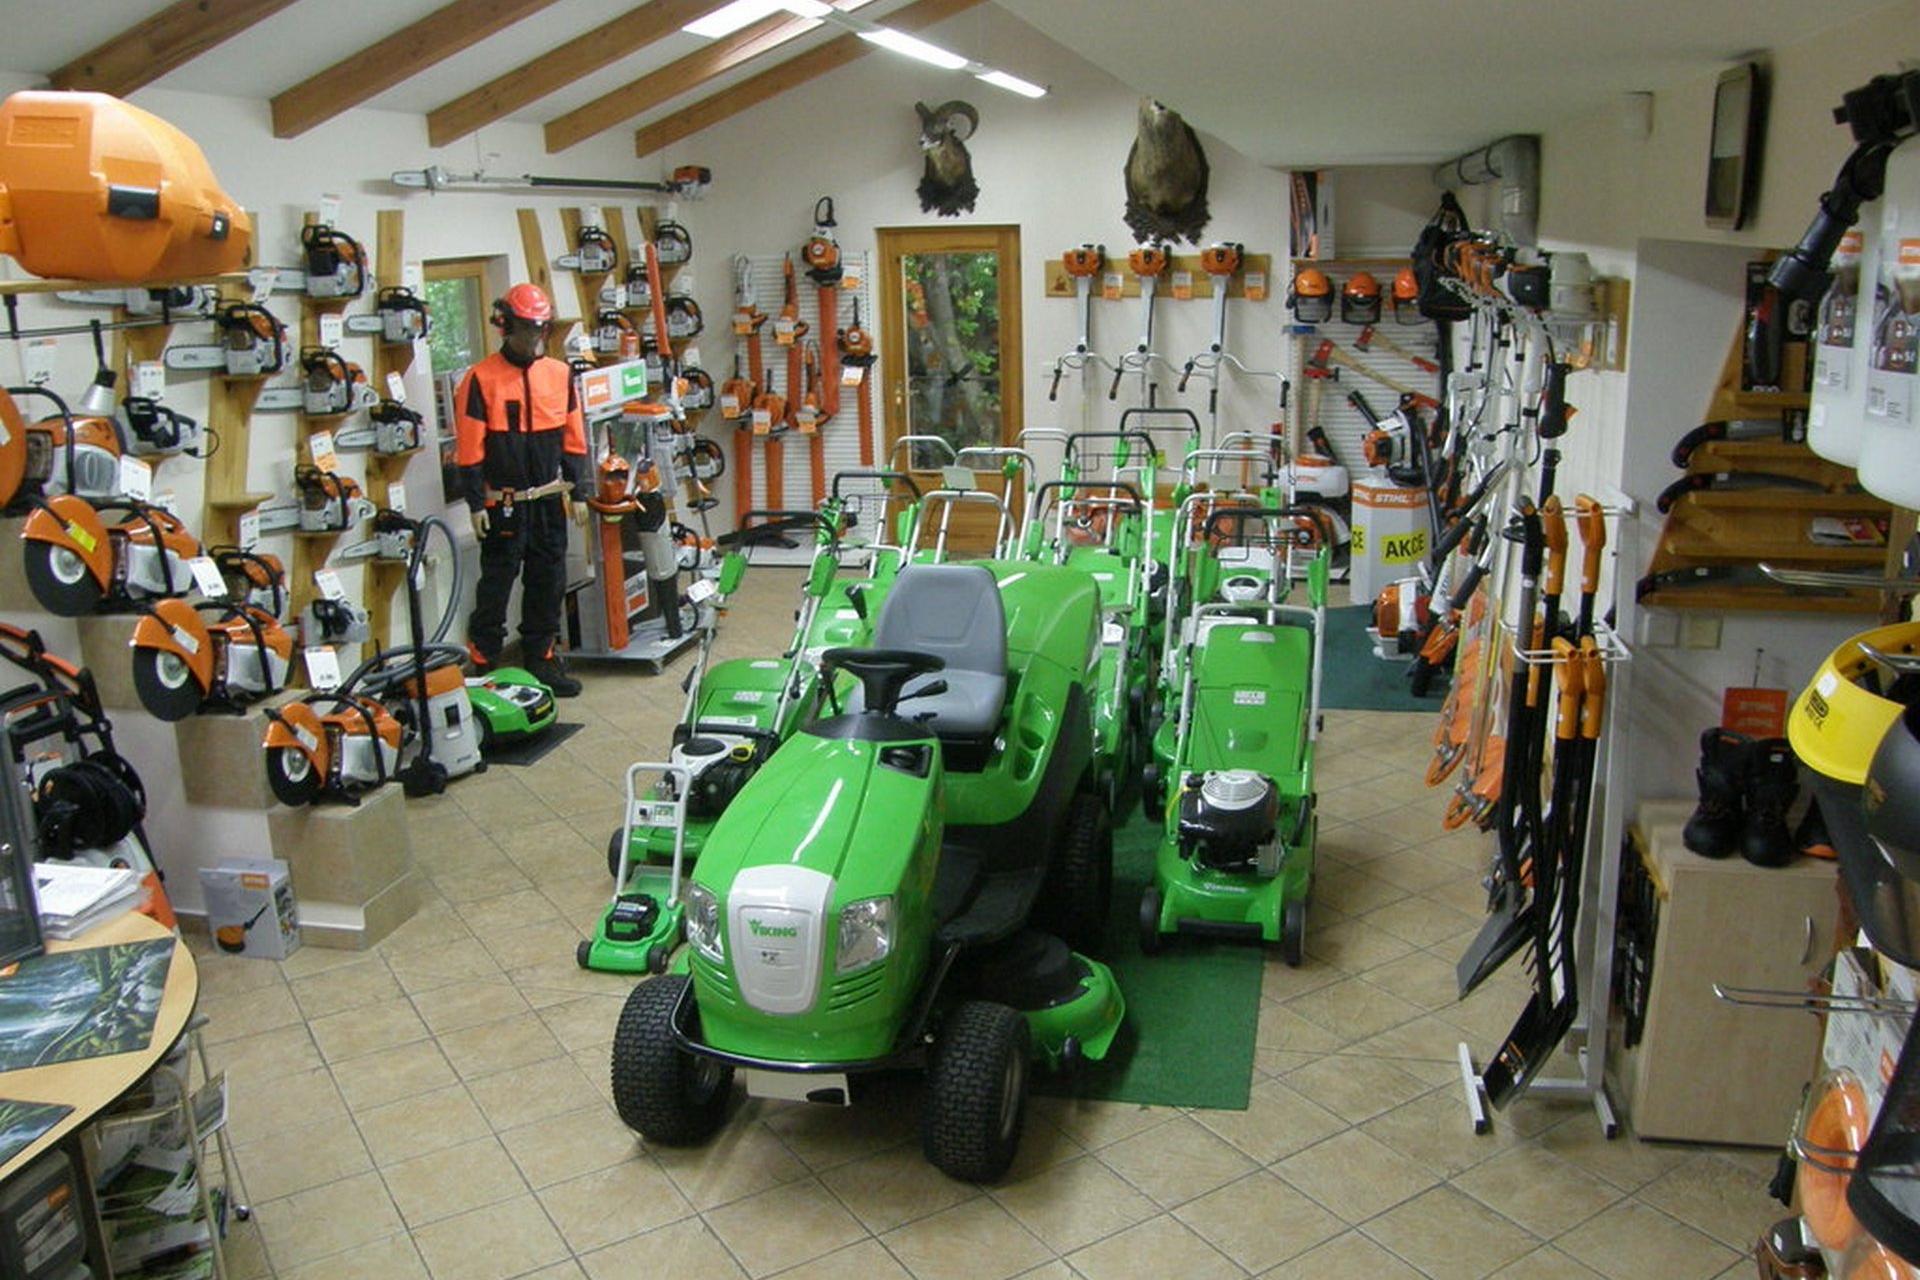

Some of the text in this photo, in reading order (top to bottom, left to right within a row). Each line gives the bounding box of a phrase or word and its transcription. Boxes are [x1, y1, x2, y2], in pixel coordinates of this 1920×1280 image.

[1375, 493, 1409, 504] STIHL
[1385, 533, 1425, 559] AKCE
[747, 918, 798, 938] VIKING
